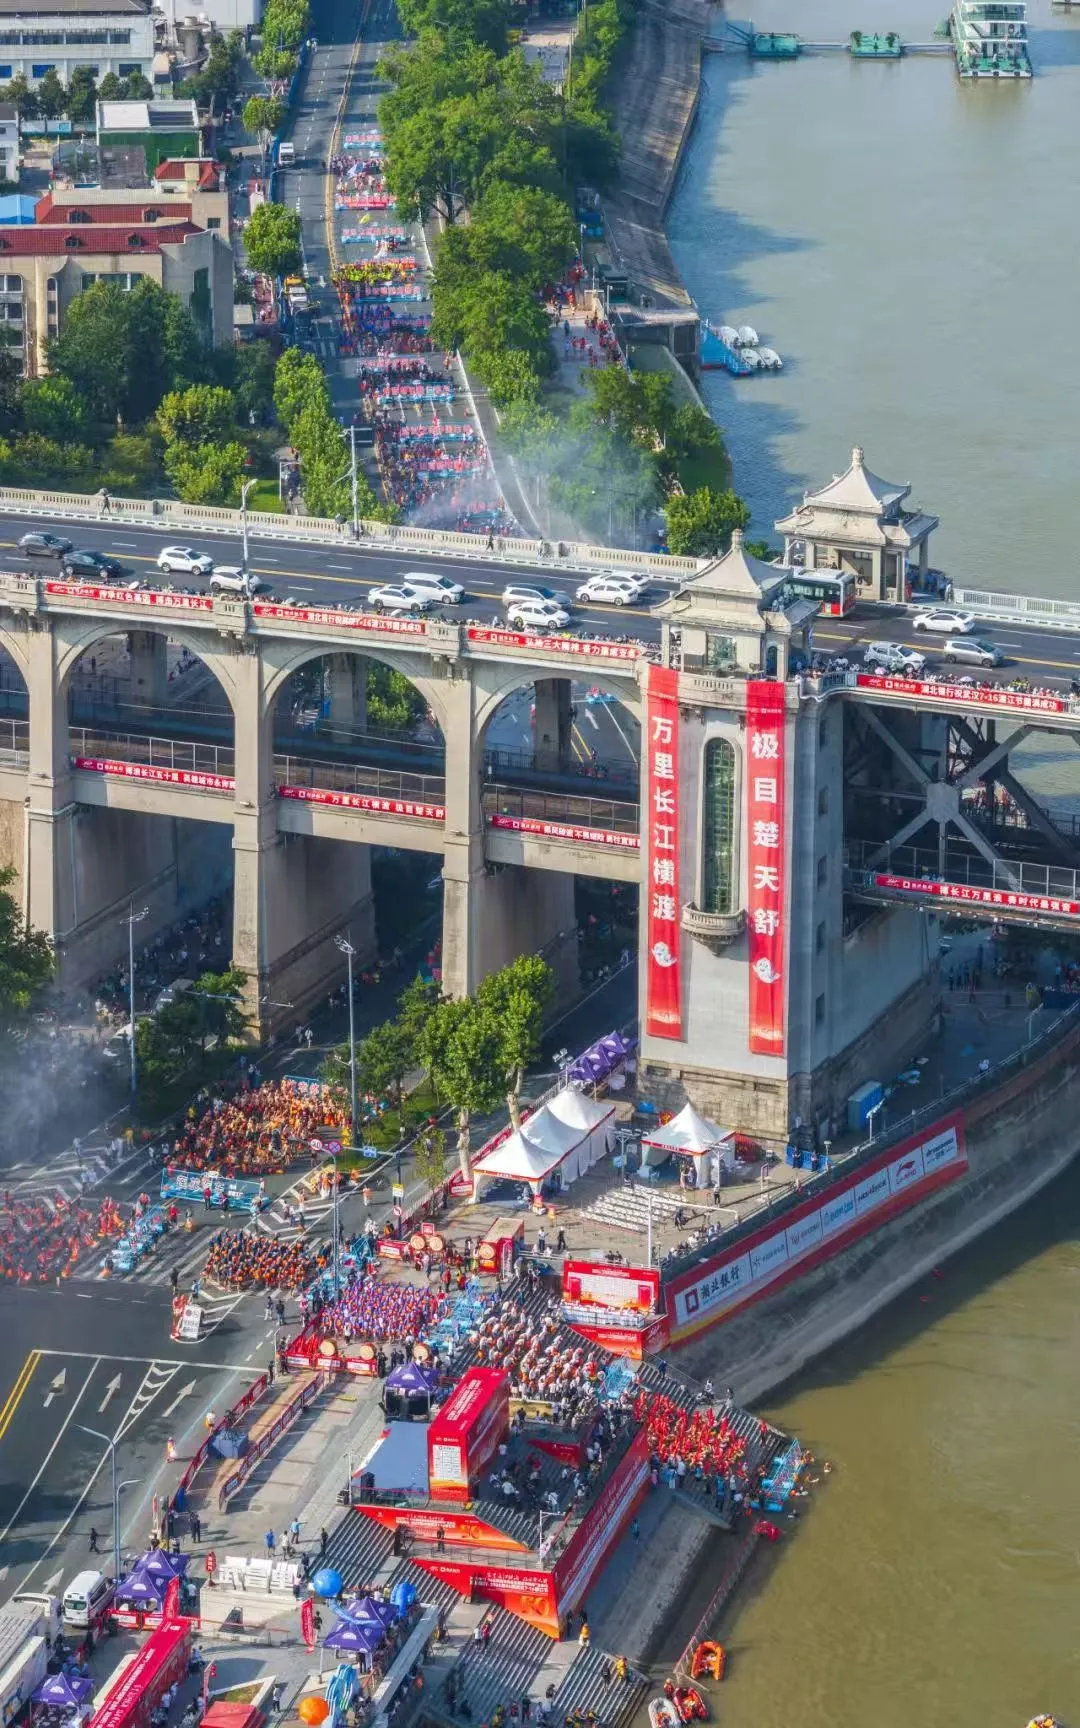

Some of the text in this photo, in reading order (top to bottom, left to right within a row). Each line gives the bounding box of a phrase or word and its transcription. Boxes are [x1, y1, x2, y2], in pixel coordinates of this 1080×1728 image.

[99, 589, 152, 604] 传承红色基因
[332, 795, 444, 819] 万里长江横渡 极目楚天舒
[652, 715, 676, 921] 万里长江横渡
[751, 731, 780, 937] 极目楚天舒
[701, 1265, 741, 1300] 湖北银行
